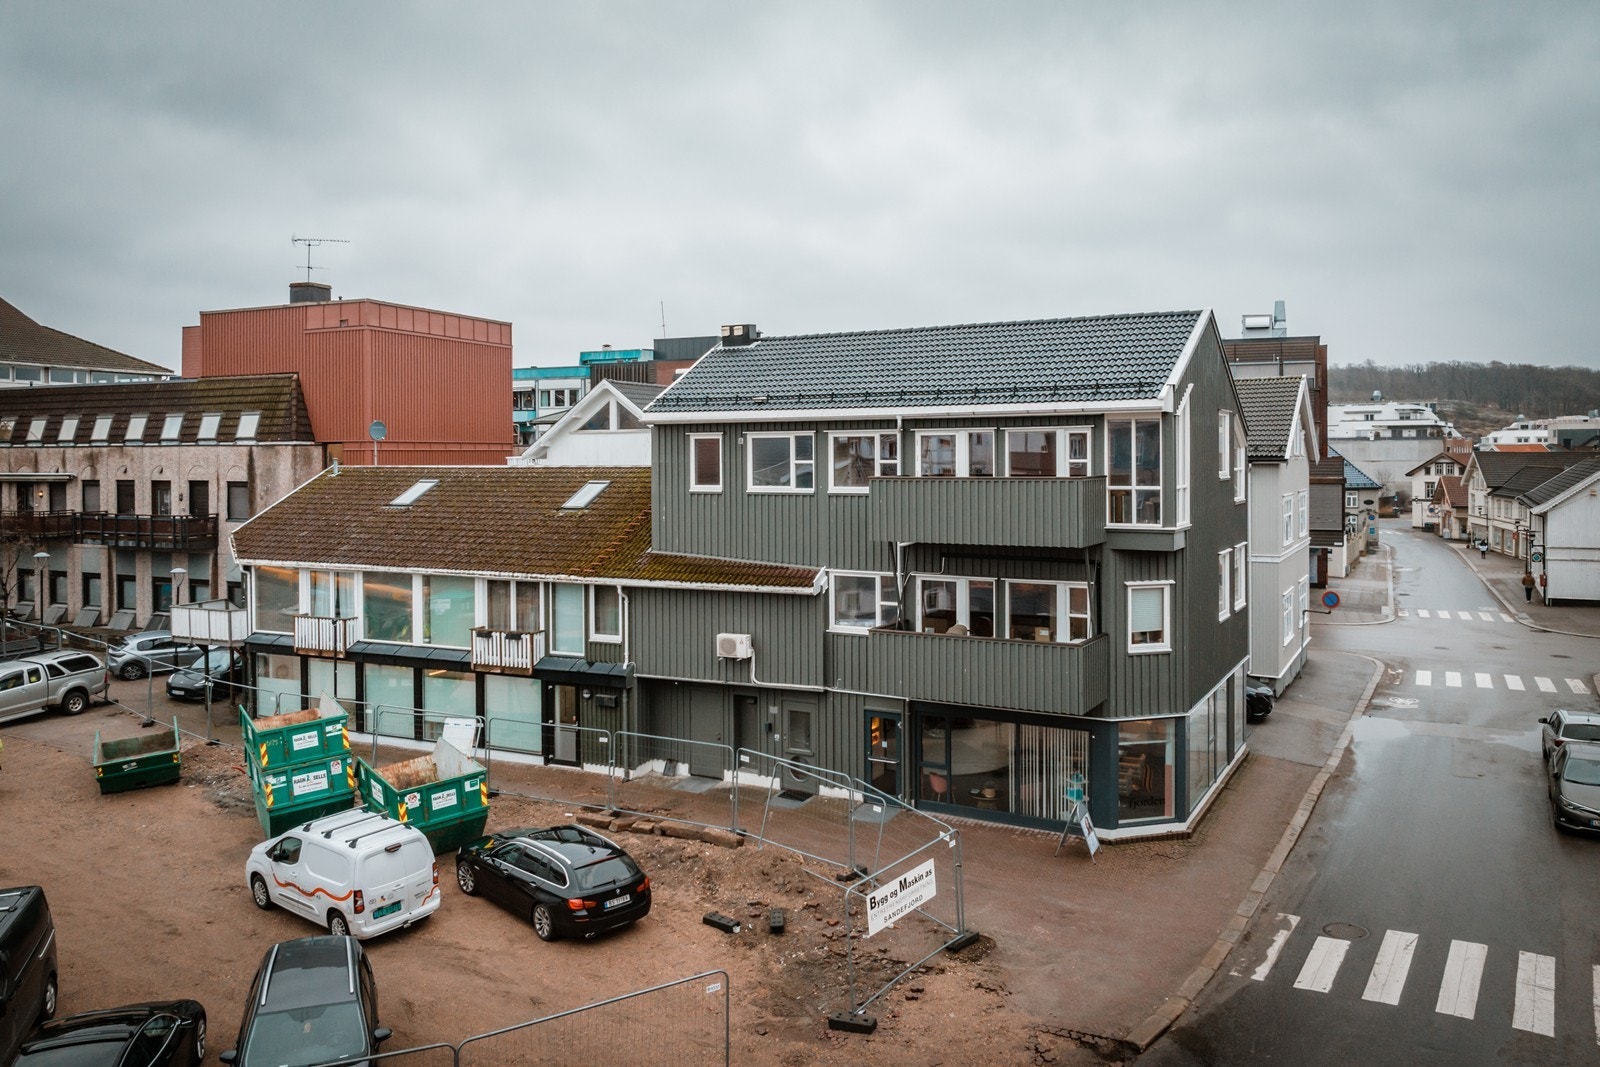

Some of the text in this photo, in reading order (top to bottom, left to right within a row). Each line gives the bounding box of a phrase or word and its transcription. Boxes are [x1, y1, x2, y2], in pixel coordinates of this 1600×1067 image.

[312, 773, 327, 781] SELLS
[869, 868, 933, 911] Bygg og Maskin as
[883, 894, 924, 923] SANDEFJORD
